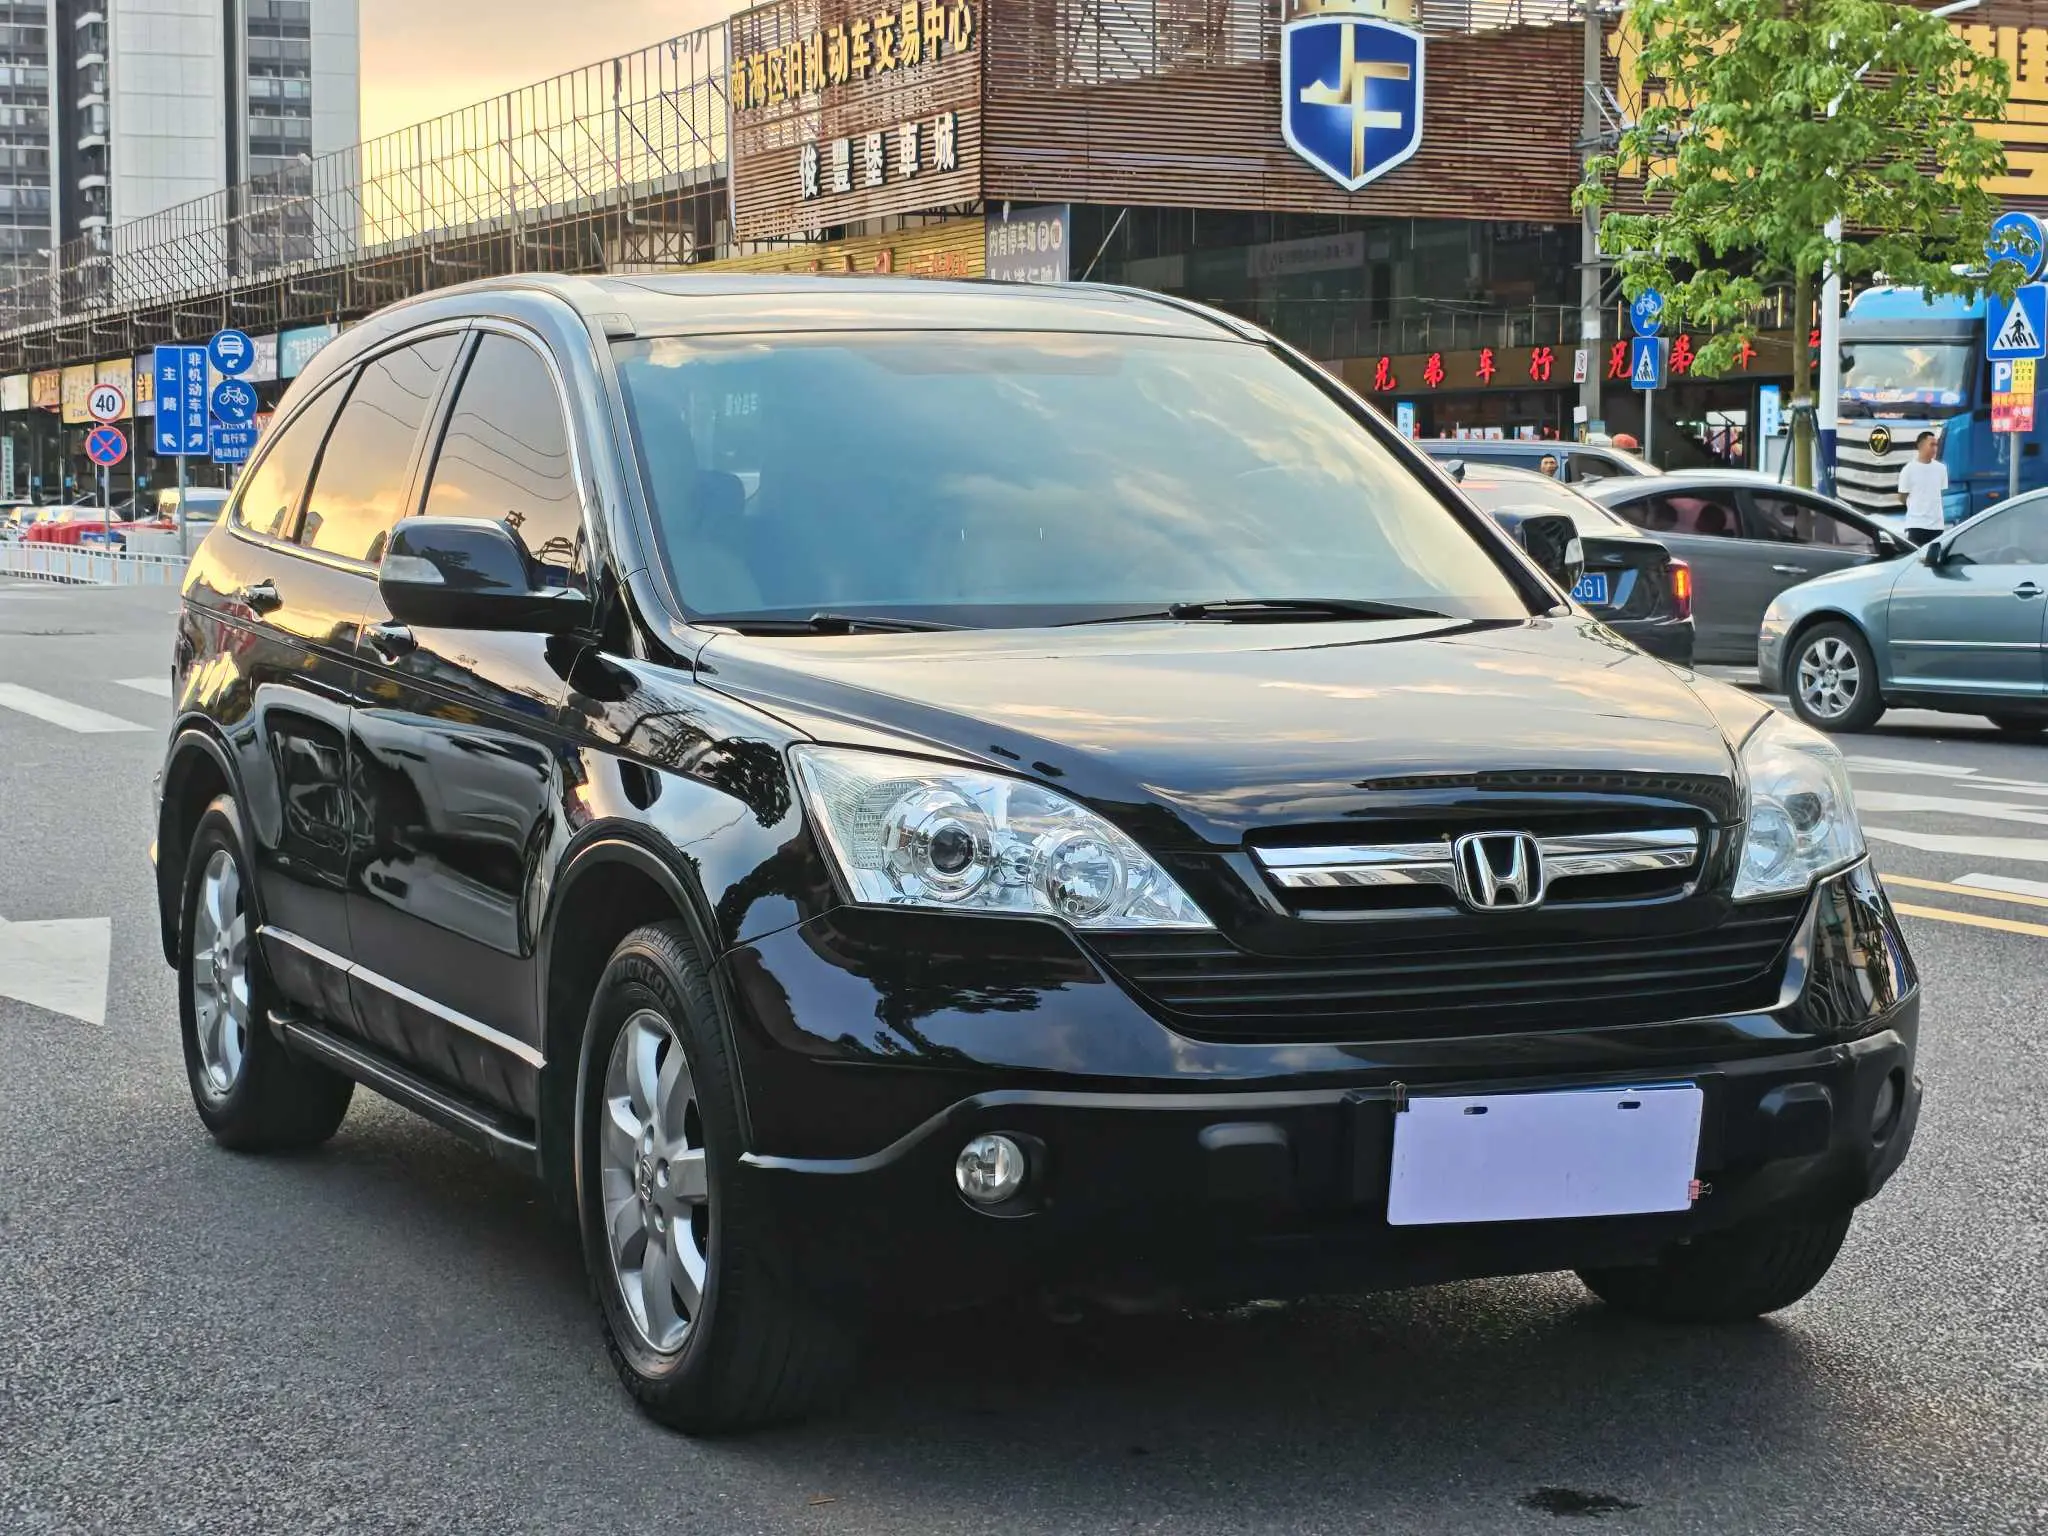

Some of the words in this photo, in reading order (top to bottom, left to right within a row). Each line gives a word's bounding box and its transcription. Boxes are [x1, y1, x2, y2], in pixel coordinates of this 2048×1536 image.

[731, 0, 972, 111] 南海区旧机动车交易中心
[162, 366, 177, 411] 主路
[188, 352, 202, 427] 非机动车道
[1994, 361, 2011, 391] P
[96, 394, 115, 412] 40
[215, 447, 251, 458] 电动自行
[222, 433, 247, 444] 自行车
